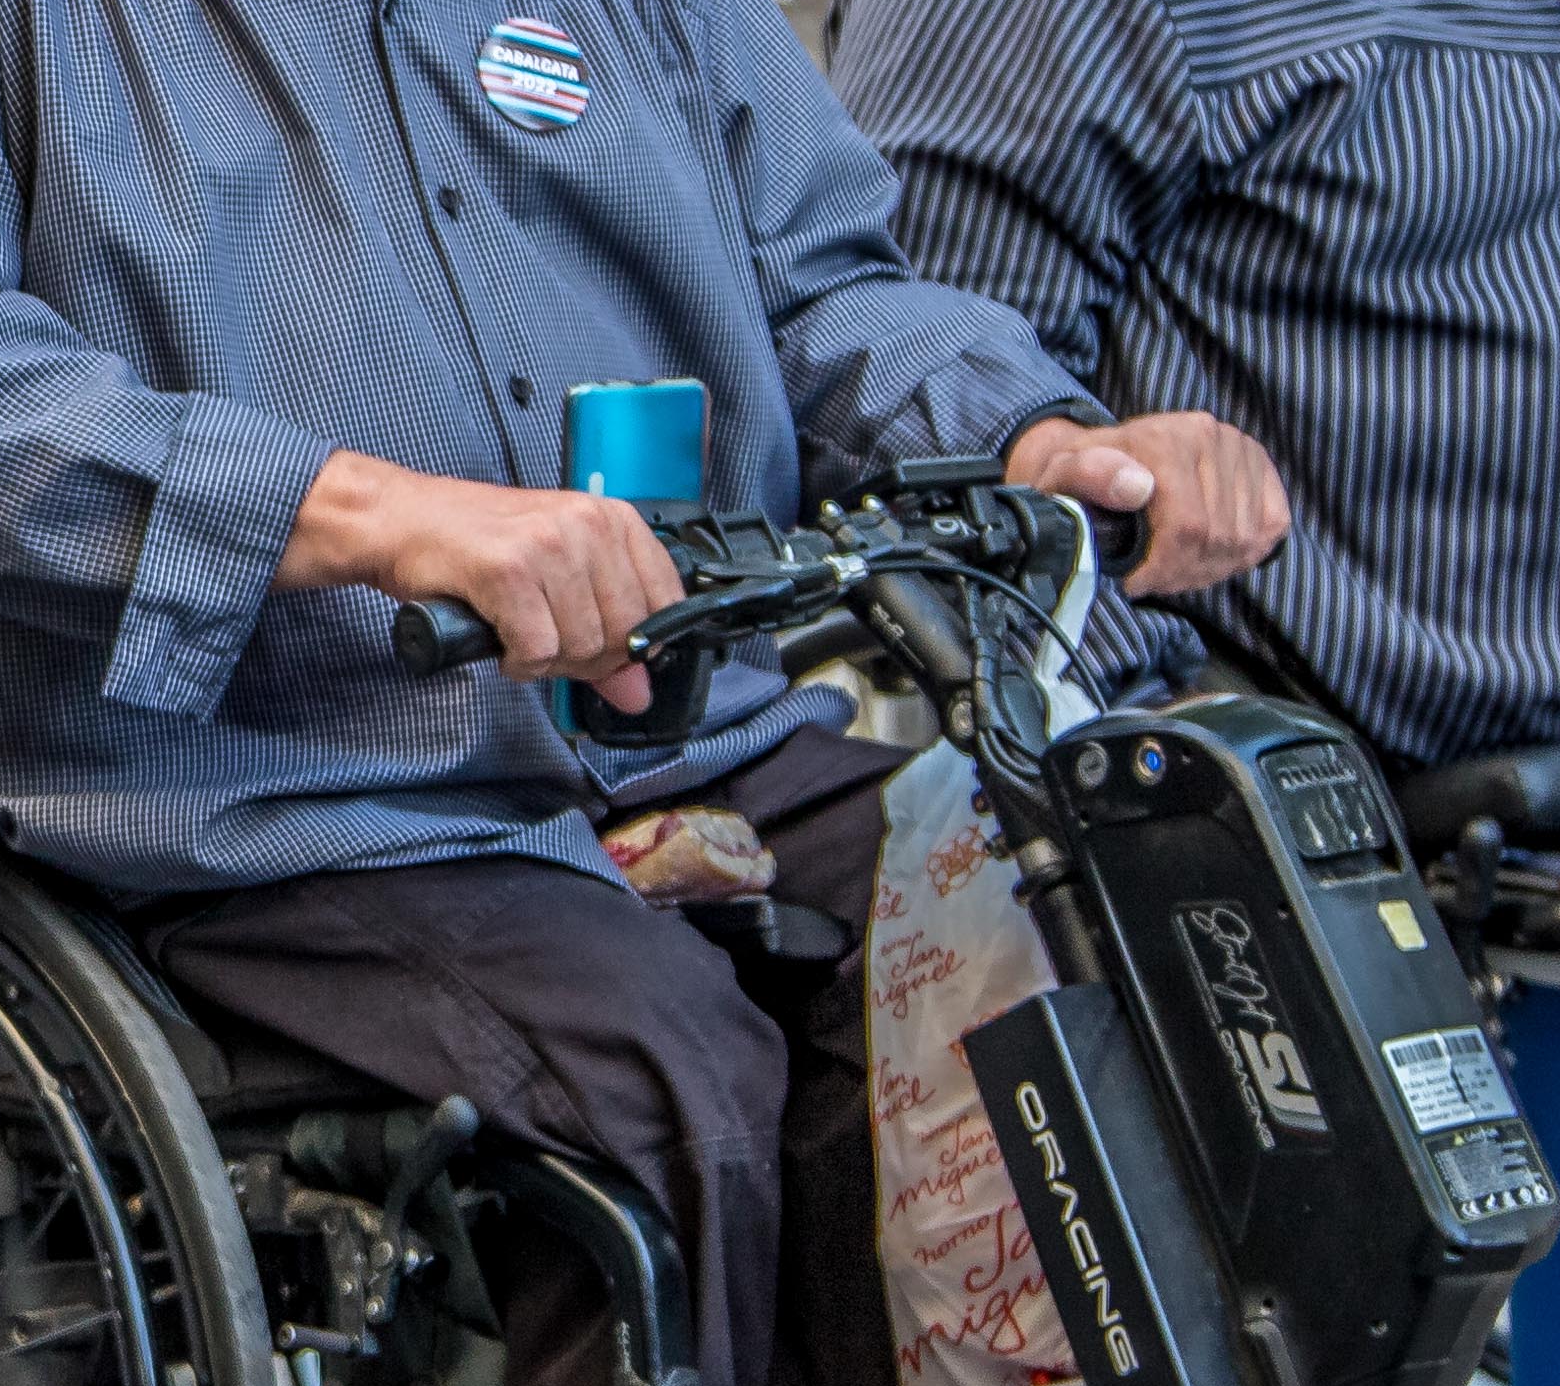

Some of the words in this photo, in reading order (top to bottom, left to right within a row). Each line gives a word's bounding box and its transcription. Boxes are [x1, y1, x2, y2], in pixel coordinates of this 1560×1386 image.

[492, 45, 580, 82] CABALGATA
[511, 72, 557, 95] 2022
[889, 1147, 1003, 1222] migue
[913, 1213, 990, 1266] horno
[962, 1197, 1031, 1294] Sa
[1014, 1080, 1140, 1379] ORACING
